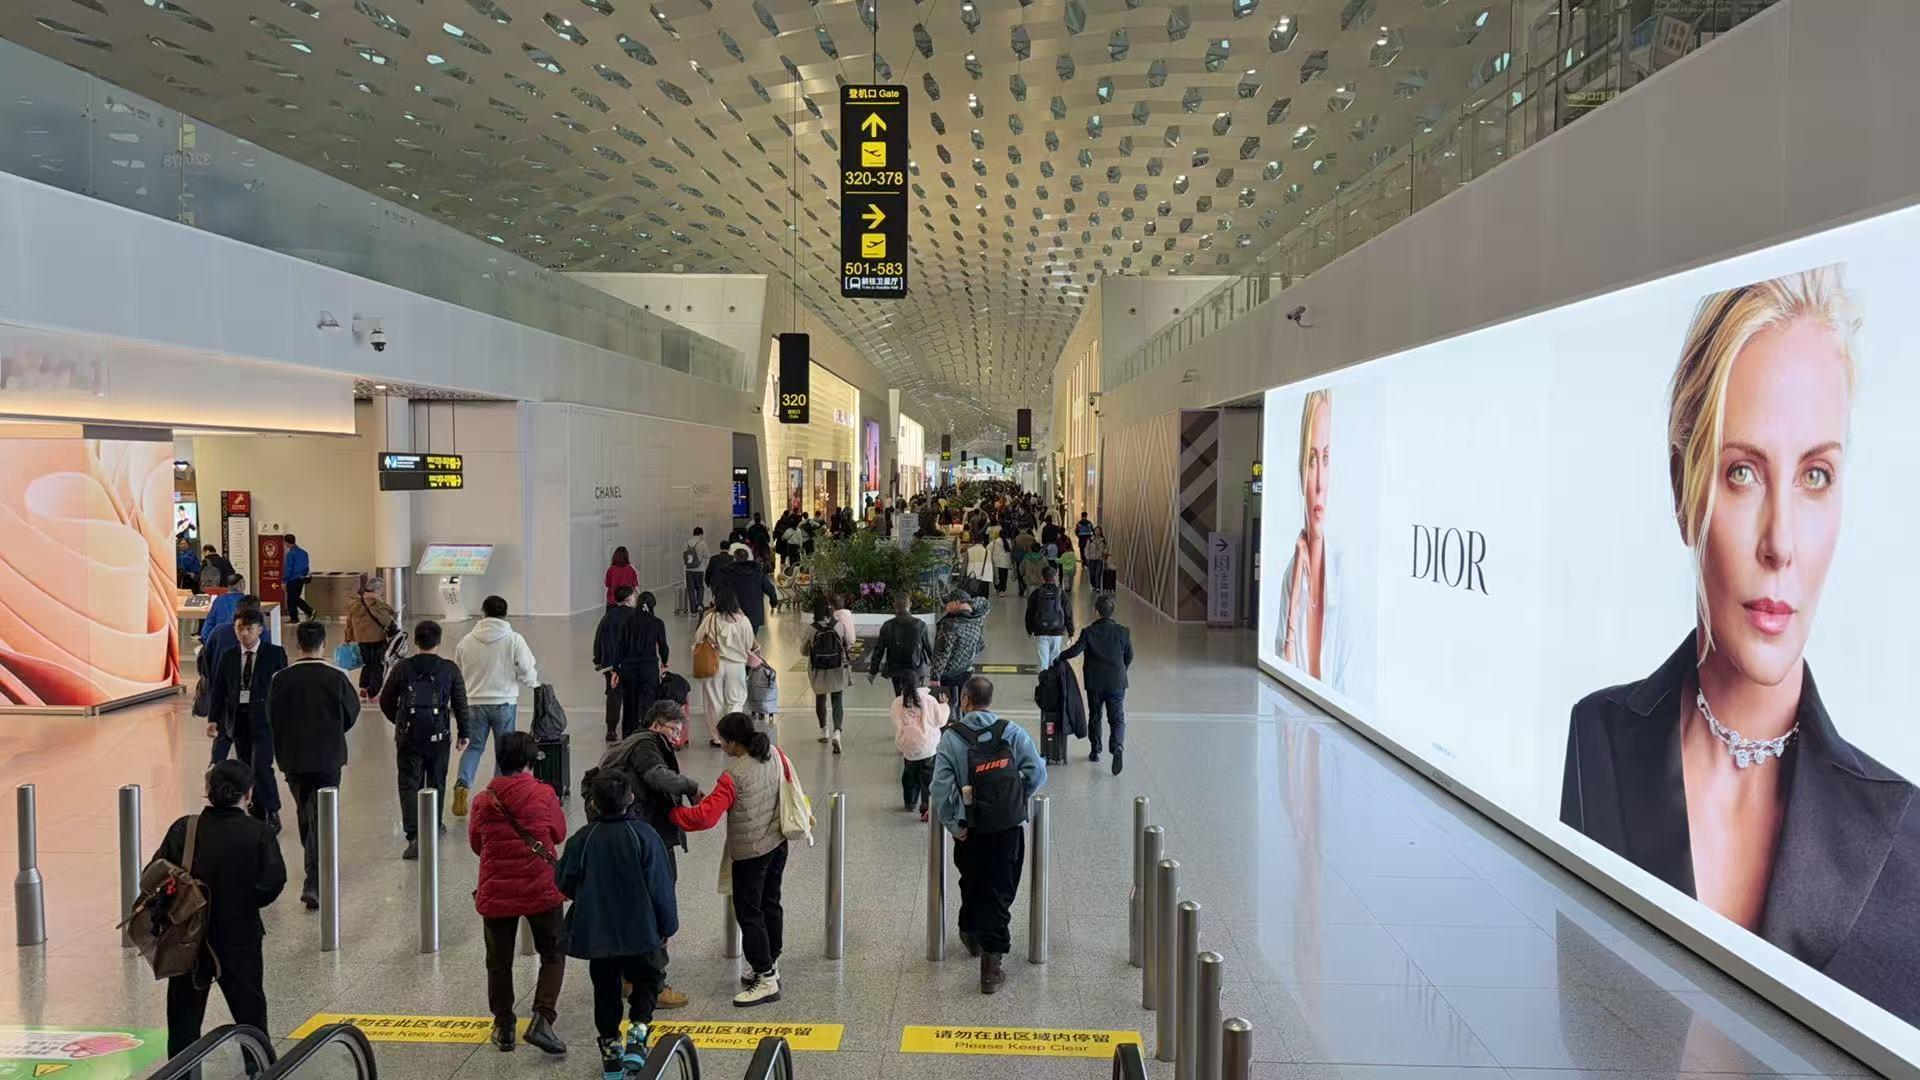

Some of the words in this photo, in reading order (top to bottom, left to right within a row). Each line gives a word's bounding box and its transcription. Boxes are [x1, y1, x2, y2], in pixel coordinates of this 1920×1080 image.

[849, 88, 877, 98] 登机口
[879, 89, 899, 98] Gate
[845, 171, 903, 185] 320-378
[845, 262, 903, 275] 501-583
[782, 393, 807, 406] 320
[594, 486, 622, 499] CHANEL
[1411, 524, 1489, 596] DIOR
[399, 1030, 435, 1039] Keep
[439, 1030, 479, 1038] Clear
[934, 1030, 1110, 1043] 请勿在此区域内停留
[705, 1037, 744, 1046] Keep
[1008, 1043, 1046, 1052] Keep
[1050, 1044, 1089, 1052] Clear
